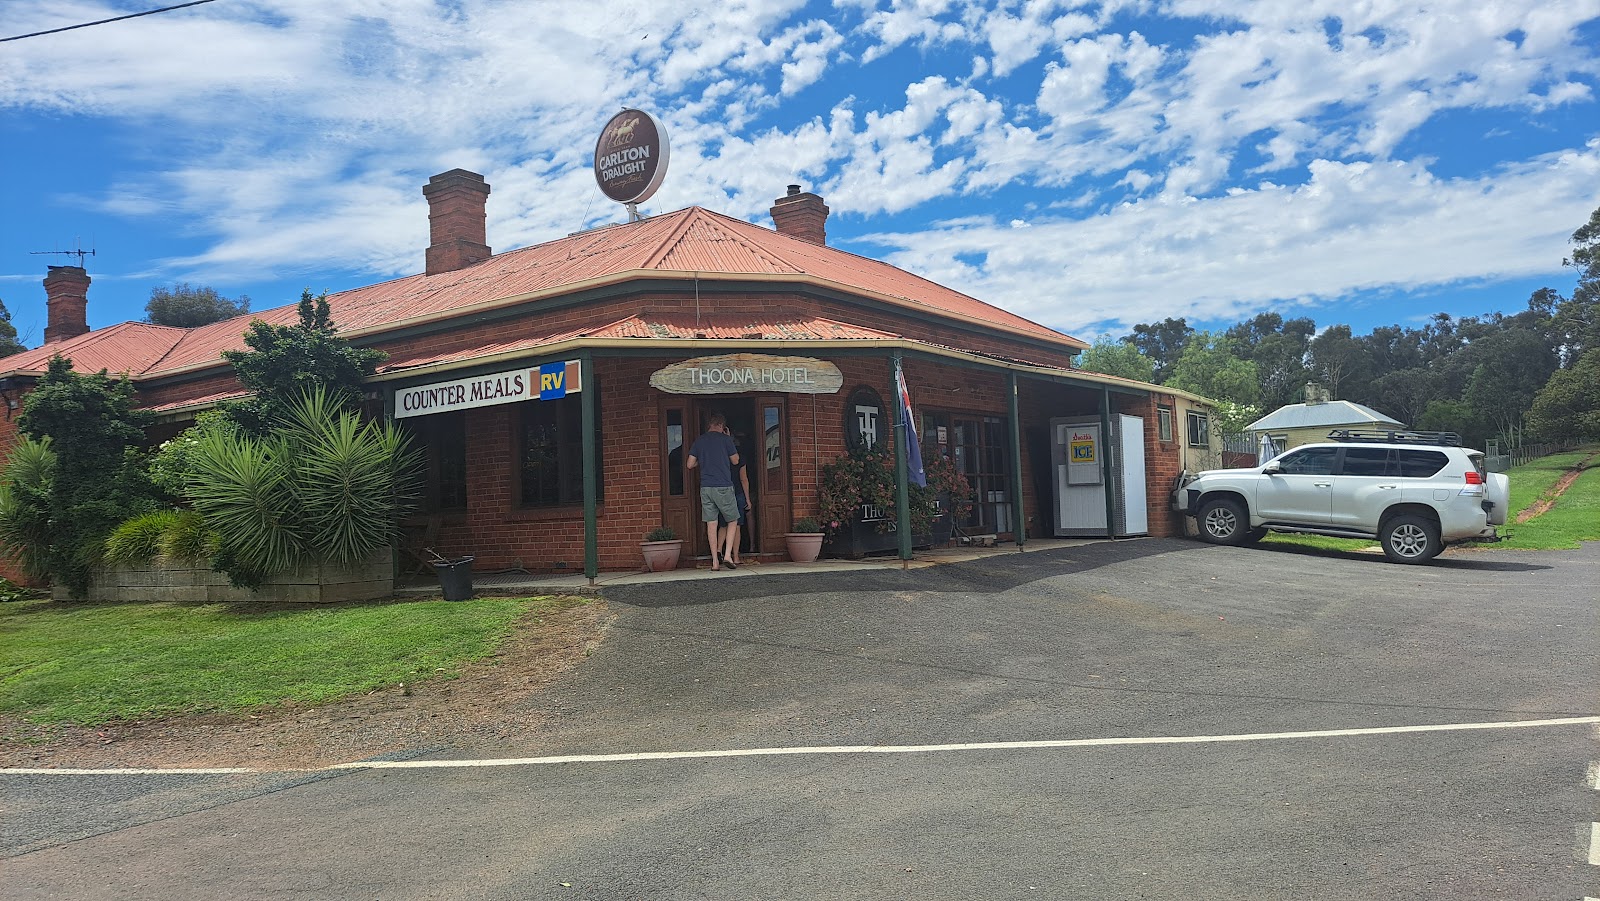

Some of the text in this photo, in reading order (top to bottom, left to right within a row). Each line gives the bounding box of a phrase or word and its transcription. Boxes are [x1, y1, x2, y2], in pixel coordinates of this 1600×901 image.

[600, 145, 650, 170] CARLTON
[602, 160, 645, 182] DRAUGHT
[541, 371, 564, 391] RV
[687, 367, 815, 384] THOONA HOTEL
[403, 375, 524, 411] COUNTER MEALS
[1073, 445, 1092, 459] ICE
[861, 504, 885, 519] THO
[887, 521, 898, 532] ES
